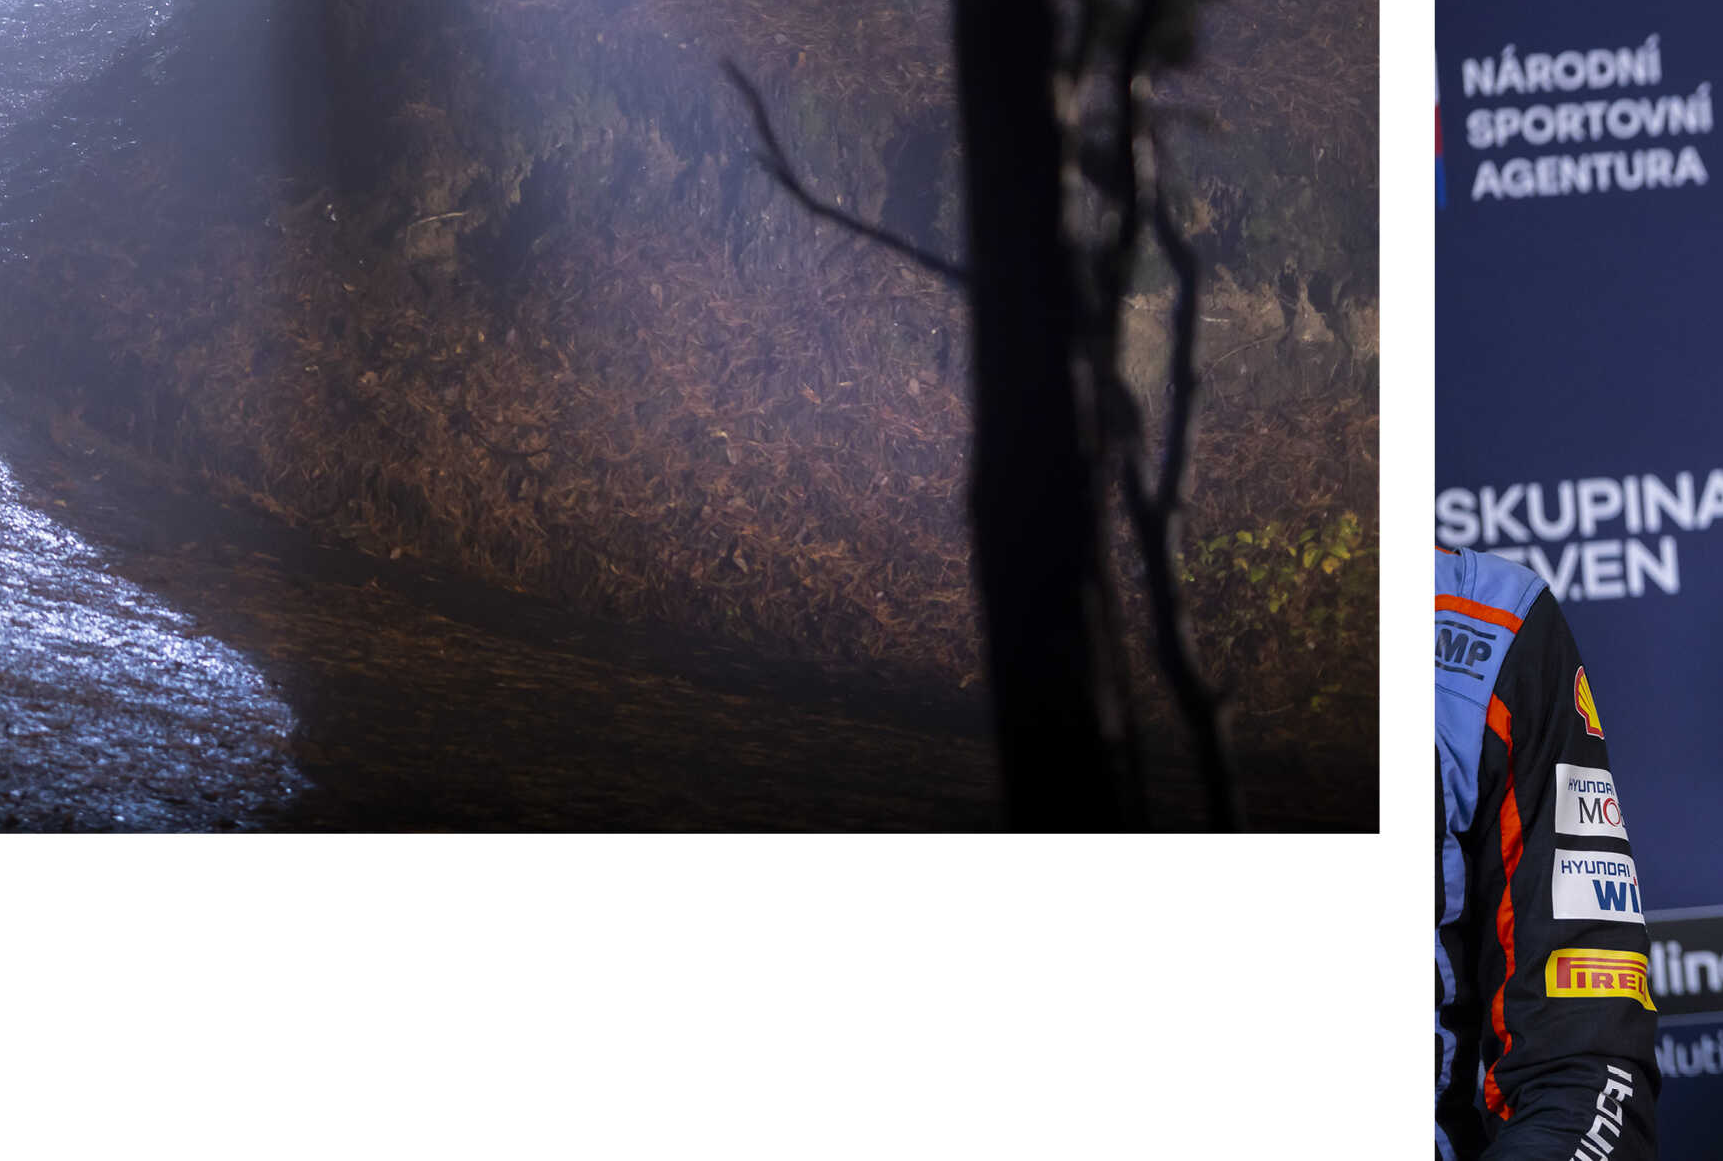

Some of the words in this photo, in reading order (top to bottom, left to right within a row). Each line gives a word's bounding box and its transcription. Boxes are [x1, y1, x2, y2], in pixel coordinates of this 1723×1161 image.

[1462, 33, 1662, 98] NÁRODNÍ
[1466, 80, 1713, 150] SPORTOVNÍ
[1471, 146, 1709, 202] AGENTURA
[1435, 627, 1492, 667] MP
[1568, 779, 1614, 795] HYUNDA
[1561, 860, 1631, 877] HYUNDAI
[1556, 956, 1648, 1004] PIREL
